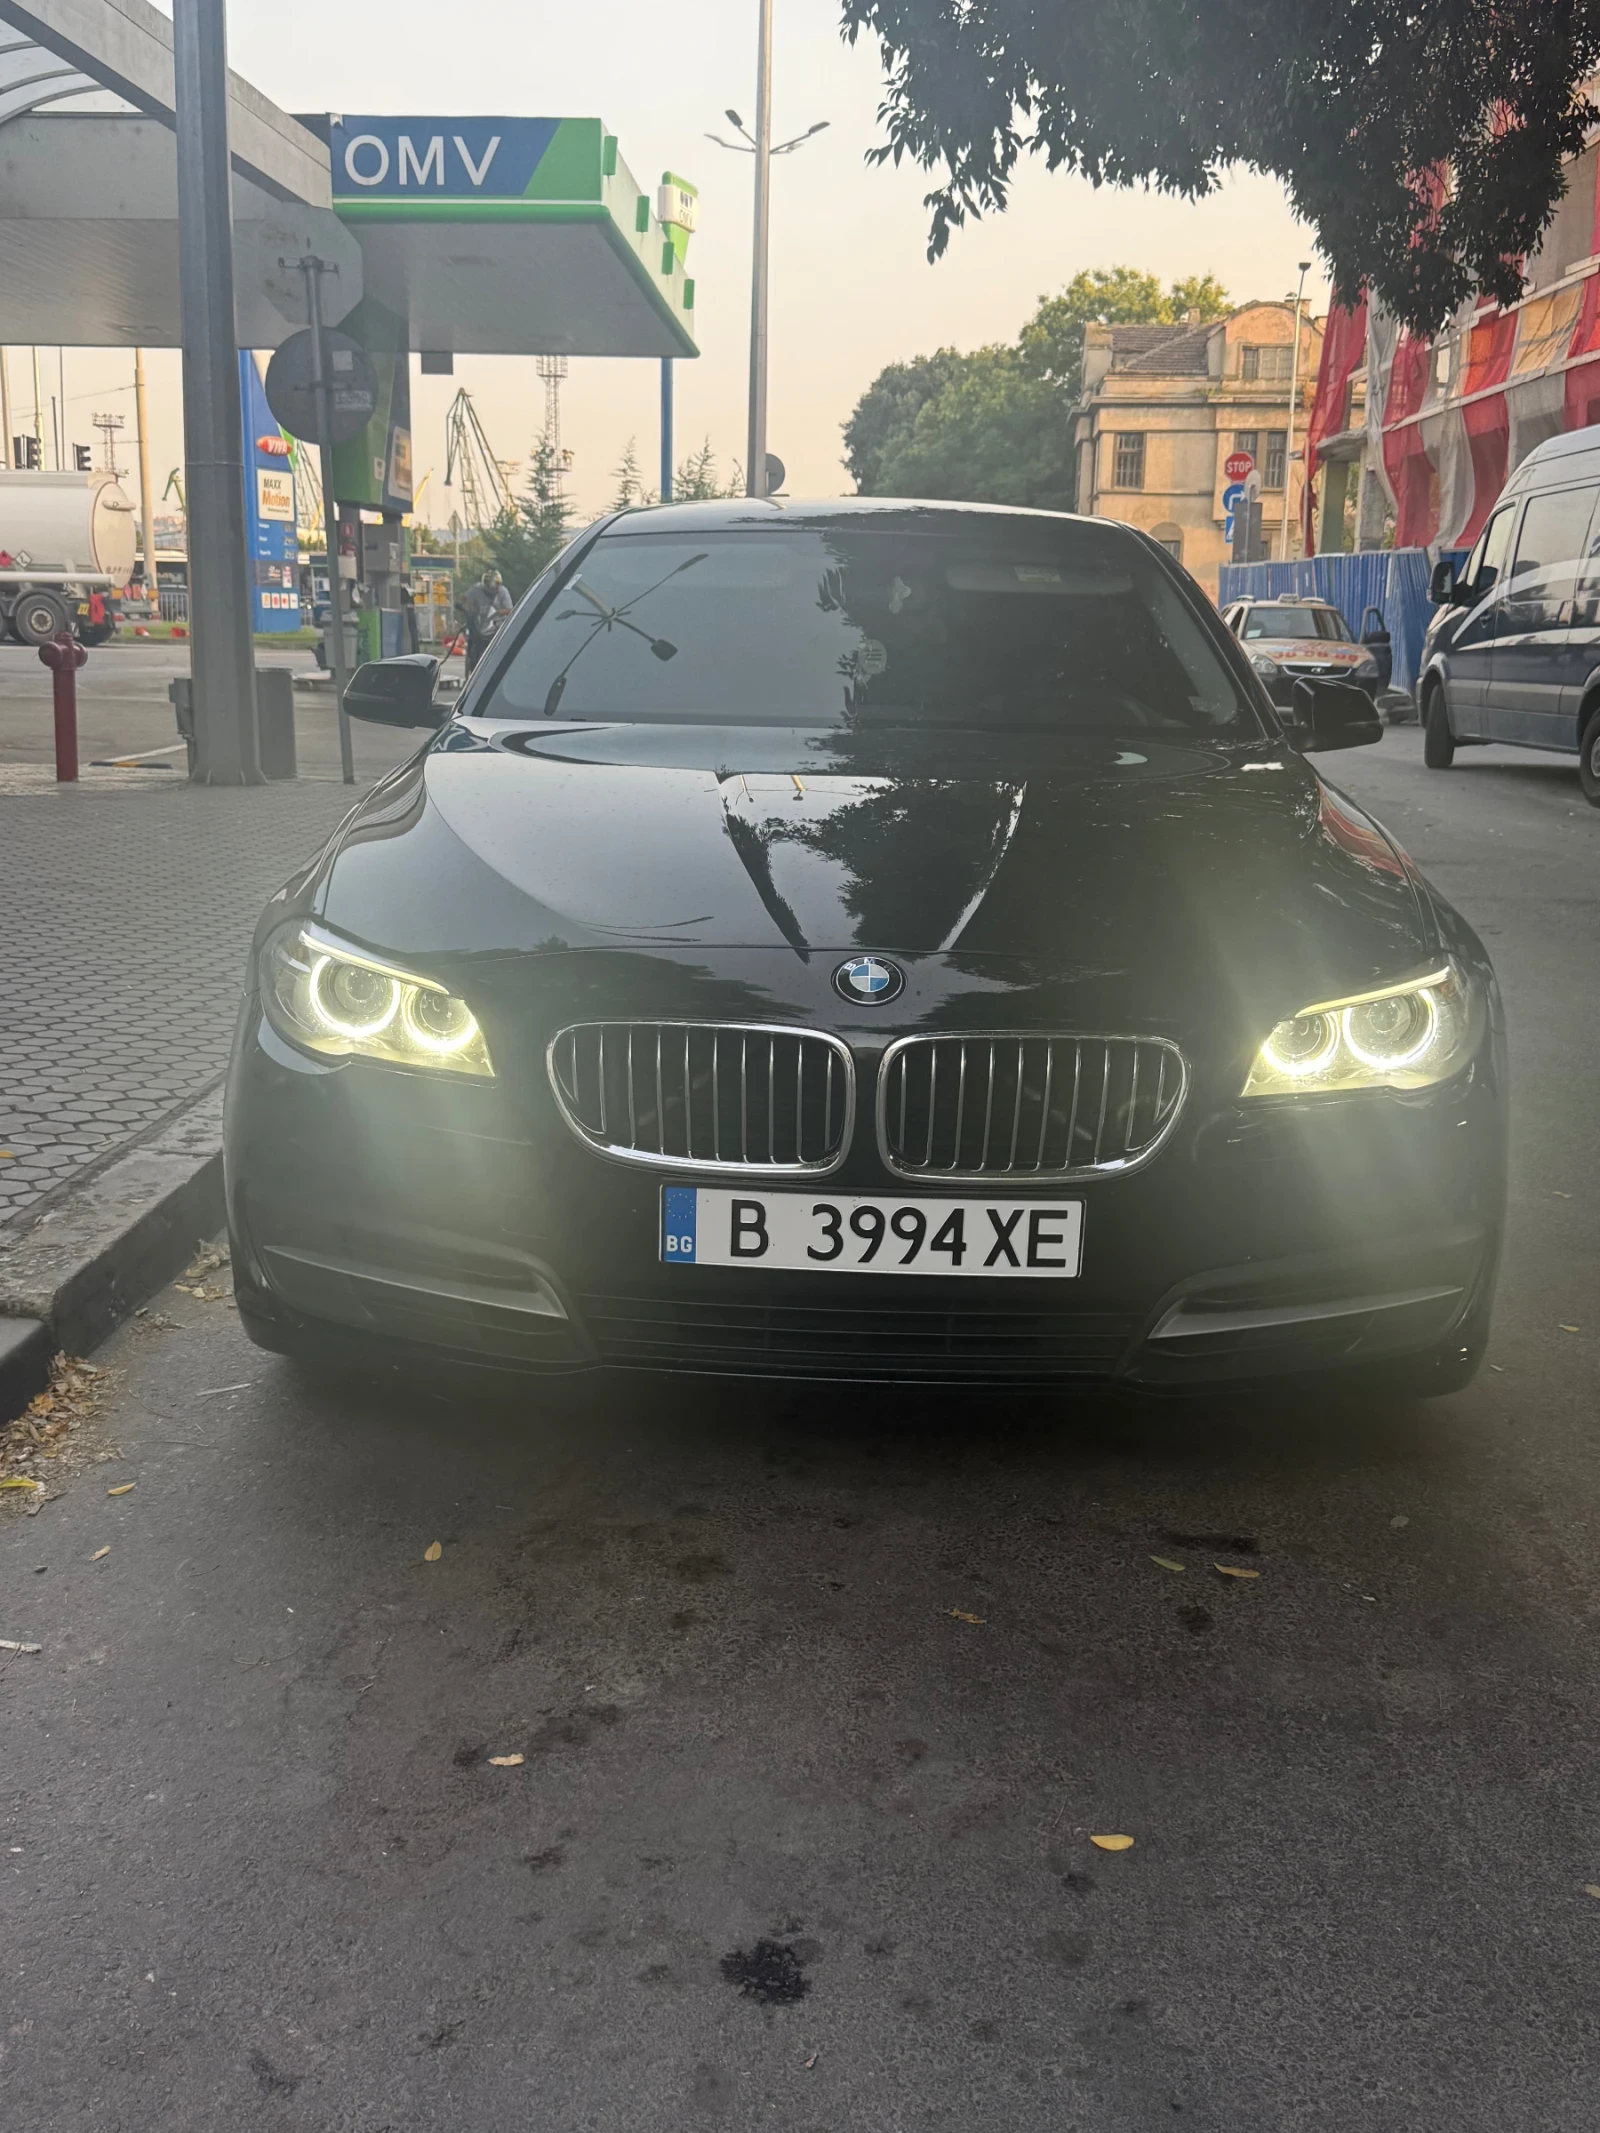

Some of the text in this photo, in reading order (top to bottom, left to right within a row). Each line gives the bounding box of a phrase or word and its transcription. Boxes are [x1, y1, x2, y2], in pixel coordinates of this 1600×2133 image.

[345, 134, 501, 186] OMV
[268, 440, 288, 454] VIVA
[1226, 461, 1252, 473] STOP
[263, 478, 282, 489] MAXX
[262, 490, 291, 508] Motion
[730, 1199, 1068, 1268] B 3994 XE
[666, 1235, 693, 1253] BG
